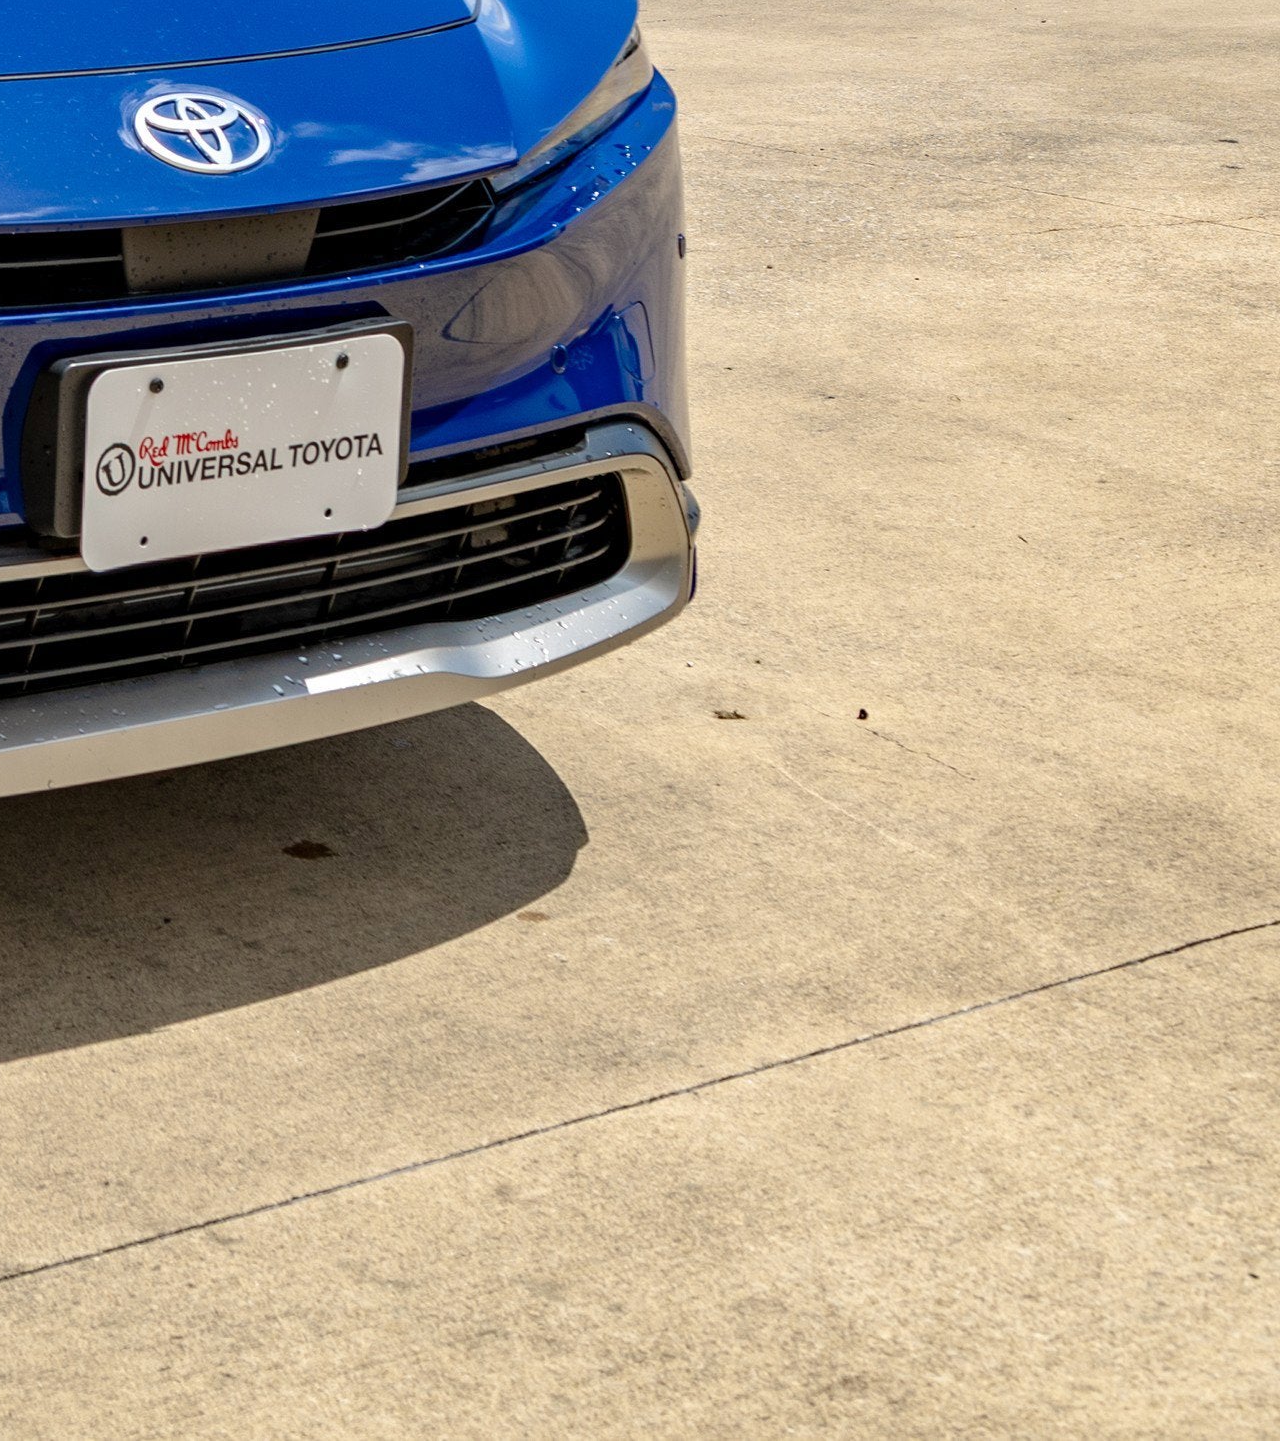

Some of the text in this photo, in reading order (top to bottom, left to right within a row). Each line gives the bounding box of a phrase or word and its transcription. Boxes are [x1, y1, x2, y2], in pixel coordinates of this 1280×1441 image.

[138, 447, 283, 489] UNIVERSAL
[289, 433, 383, 467] TOYOTA
[139, 428, 239, 466] Red McCombs
